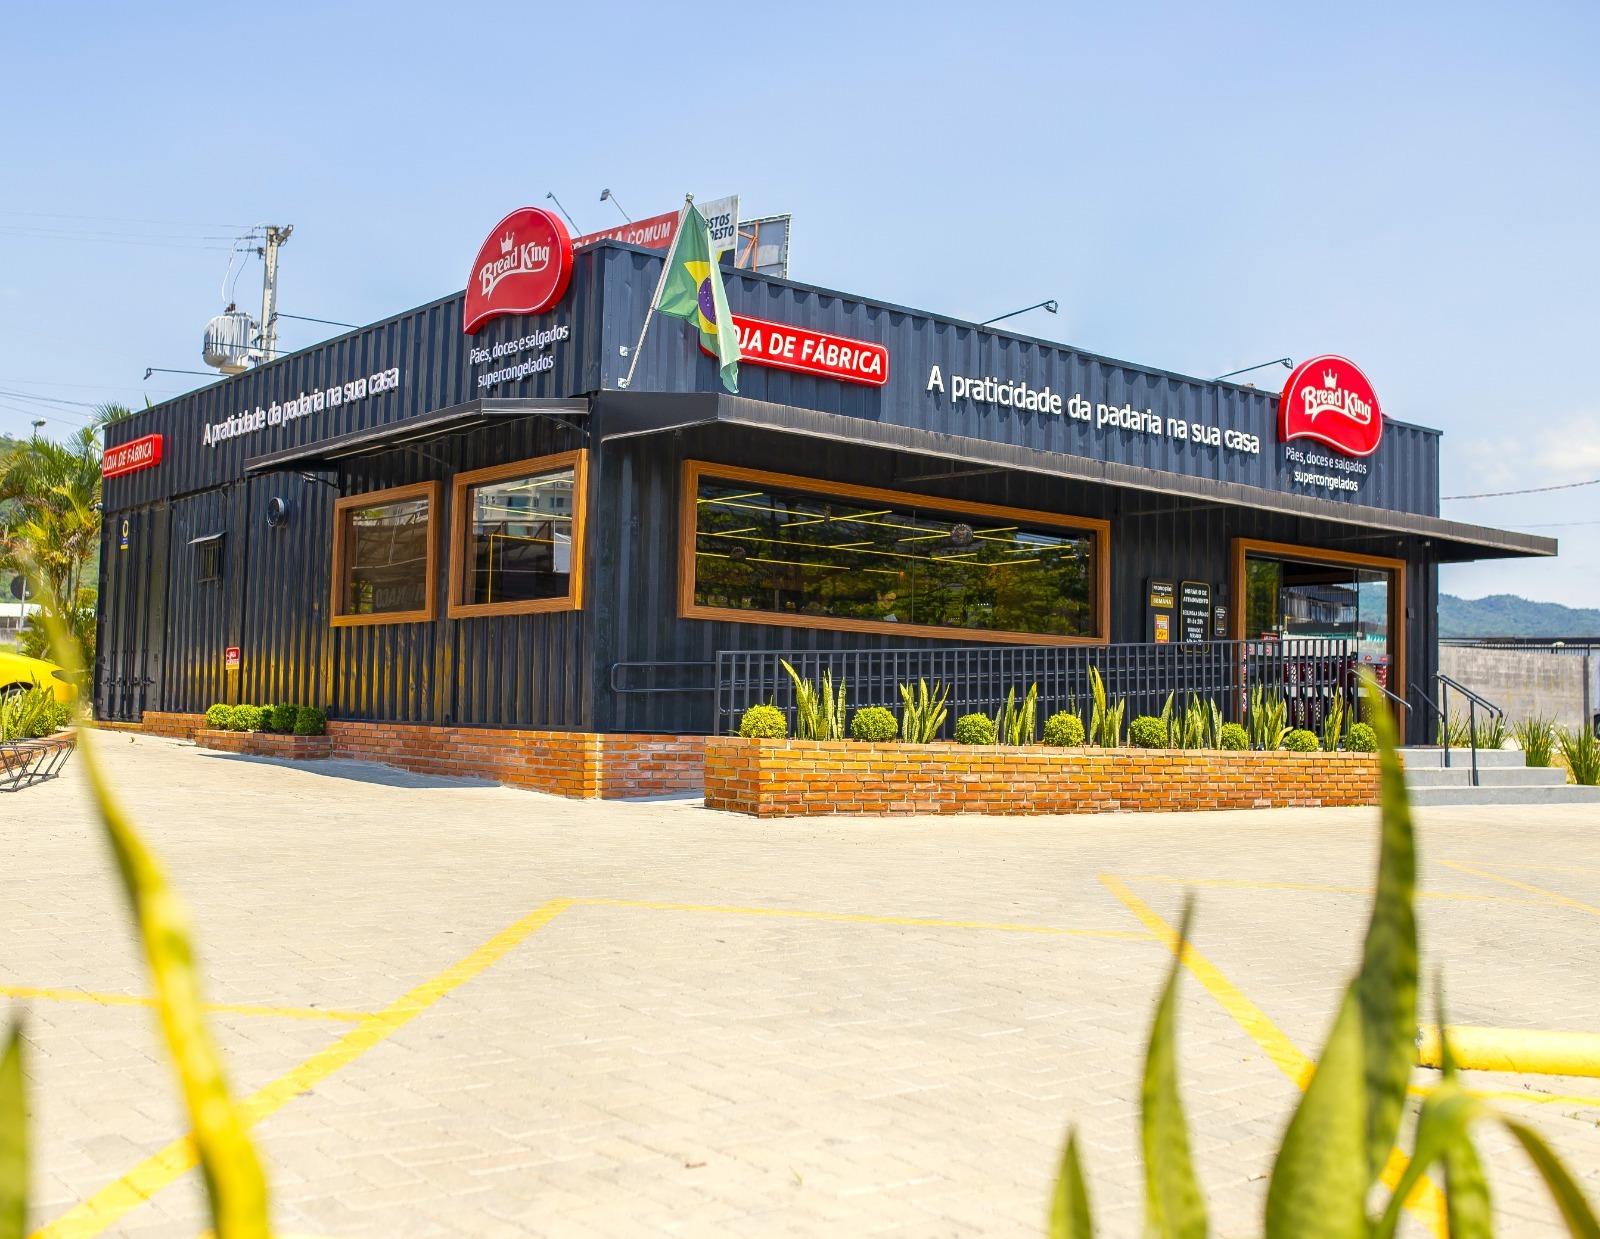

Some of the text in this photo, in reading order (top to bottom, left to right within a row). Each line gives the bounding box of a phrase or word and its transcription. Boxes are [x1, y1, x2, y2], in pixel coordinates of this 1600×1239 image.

[628, 221, 671, 245] COMUM
[478, 241, 550, 298] Bread King
[492, 342, 518, 358] doces
[518, 338, 524, 350] e
[525, 324, 569, 349] salgados
[733, 324, 881, 375] JA DE FÁBRICA
[478, 355, 554, 389] supercongelados
[203, 367, 399, 448] A praticidade da padaria na sua casa
[926, 365, 1261, 454] A praticidade da padaria na sua casa
[1300, 386, 1372, 423] Bread King
[104, 441, 152, 471] LOJA DE FÁBRICA
[1306, 451, 1329, 468] doces
[1329, 457, 1334, 468] e
[1334, 457, 1367, 475] salgados
[1294, 470, 1359, 492] supercongelados
